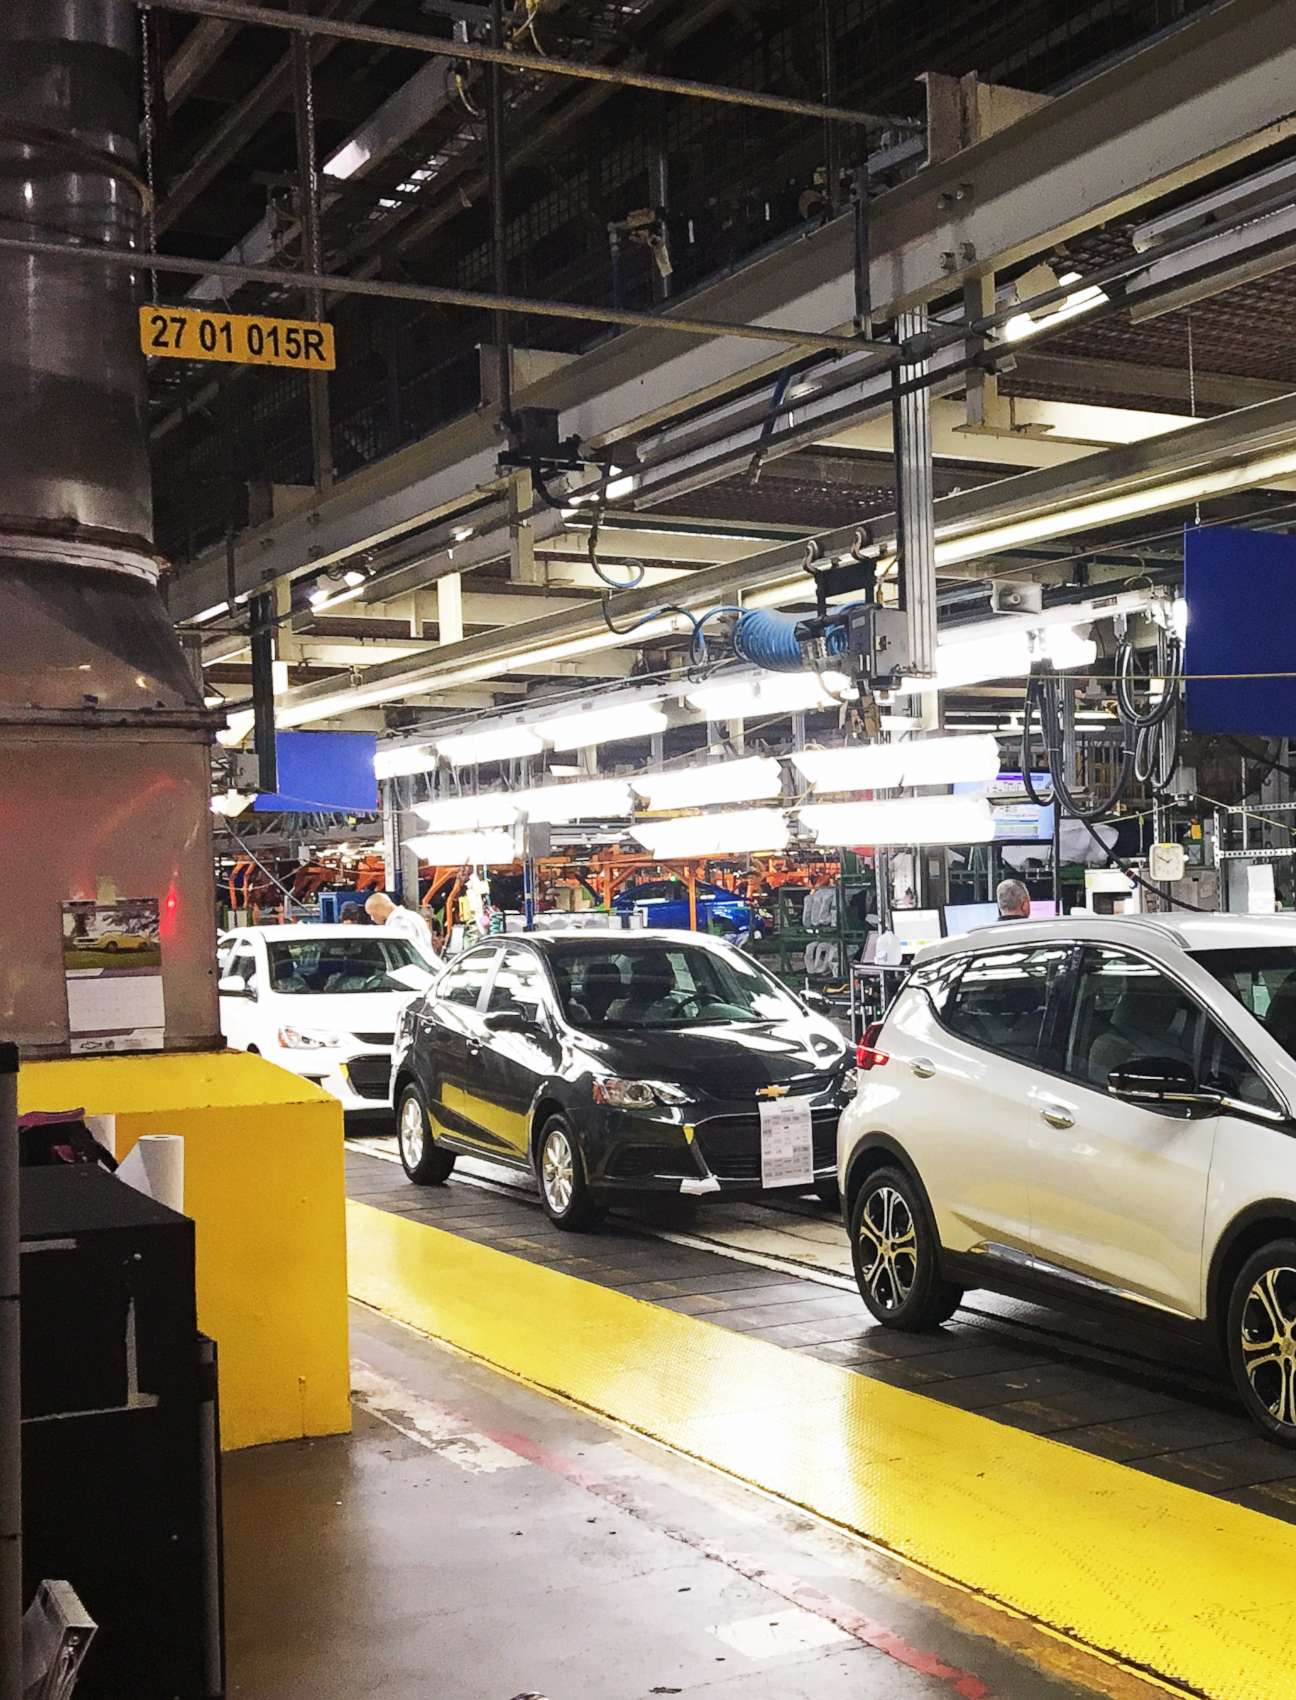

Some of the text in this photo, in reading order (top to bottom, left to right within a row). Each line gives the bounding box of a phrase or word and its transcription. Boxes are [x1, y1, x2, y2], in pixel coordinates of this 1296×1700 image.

[150, 314, 326, 362] 27 01 015R
